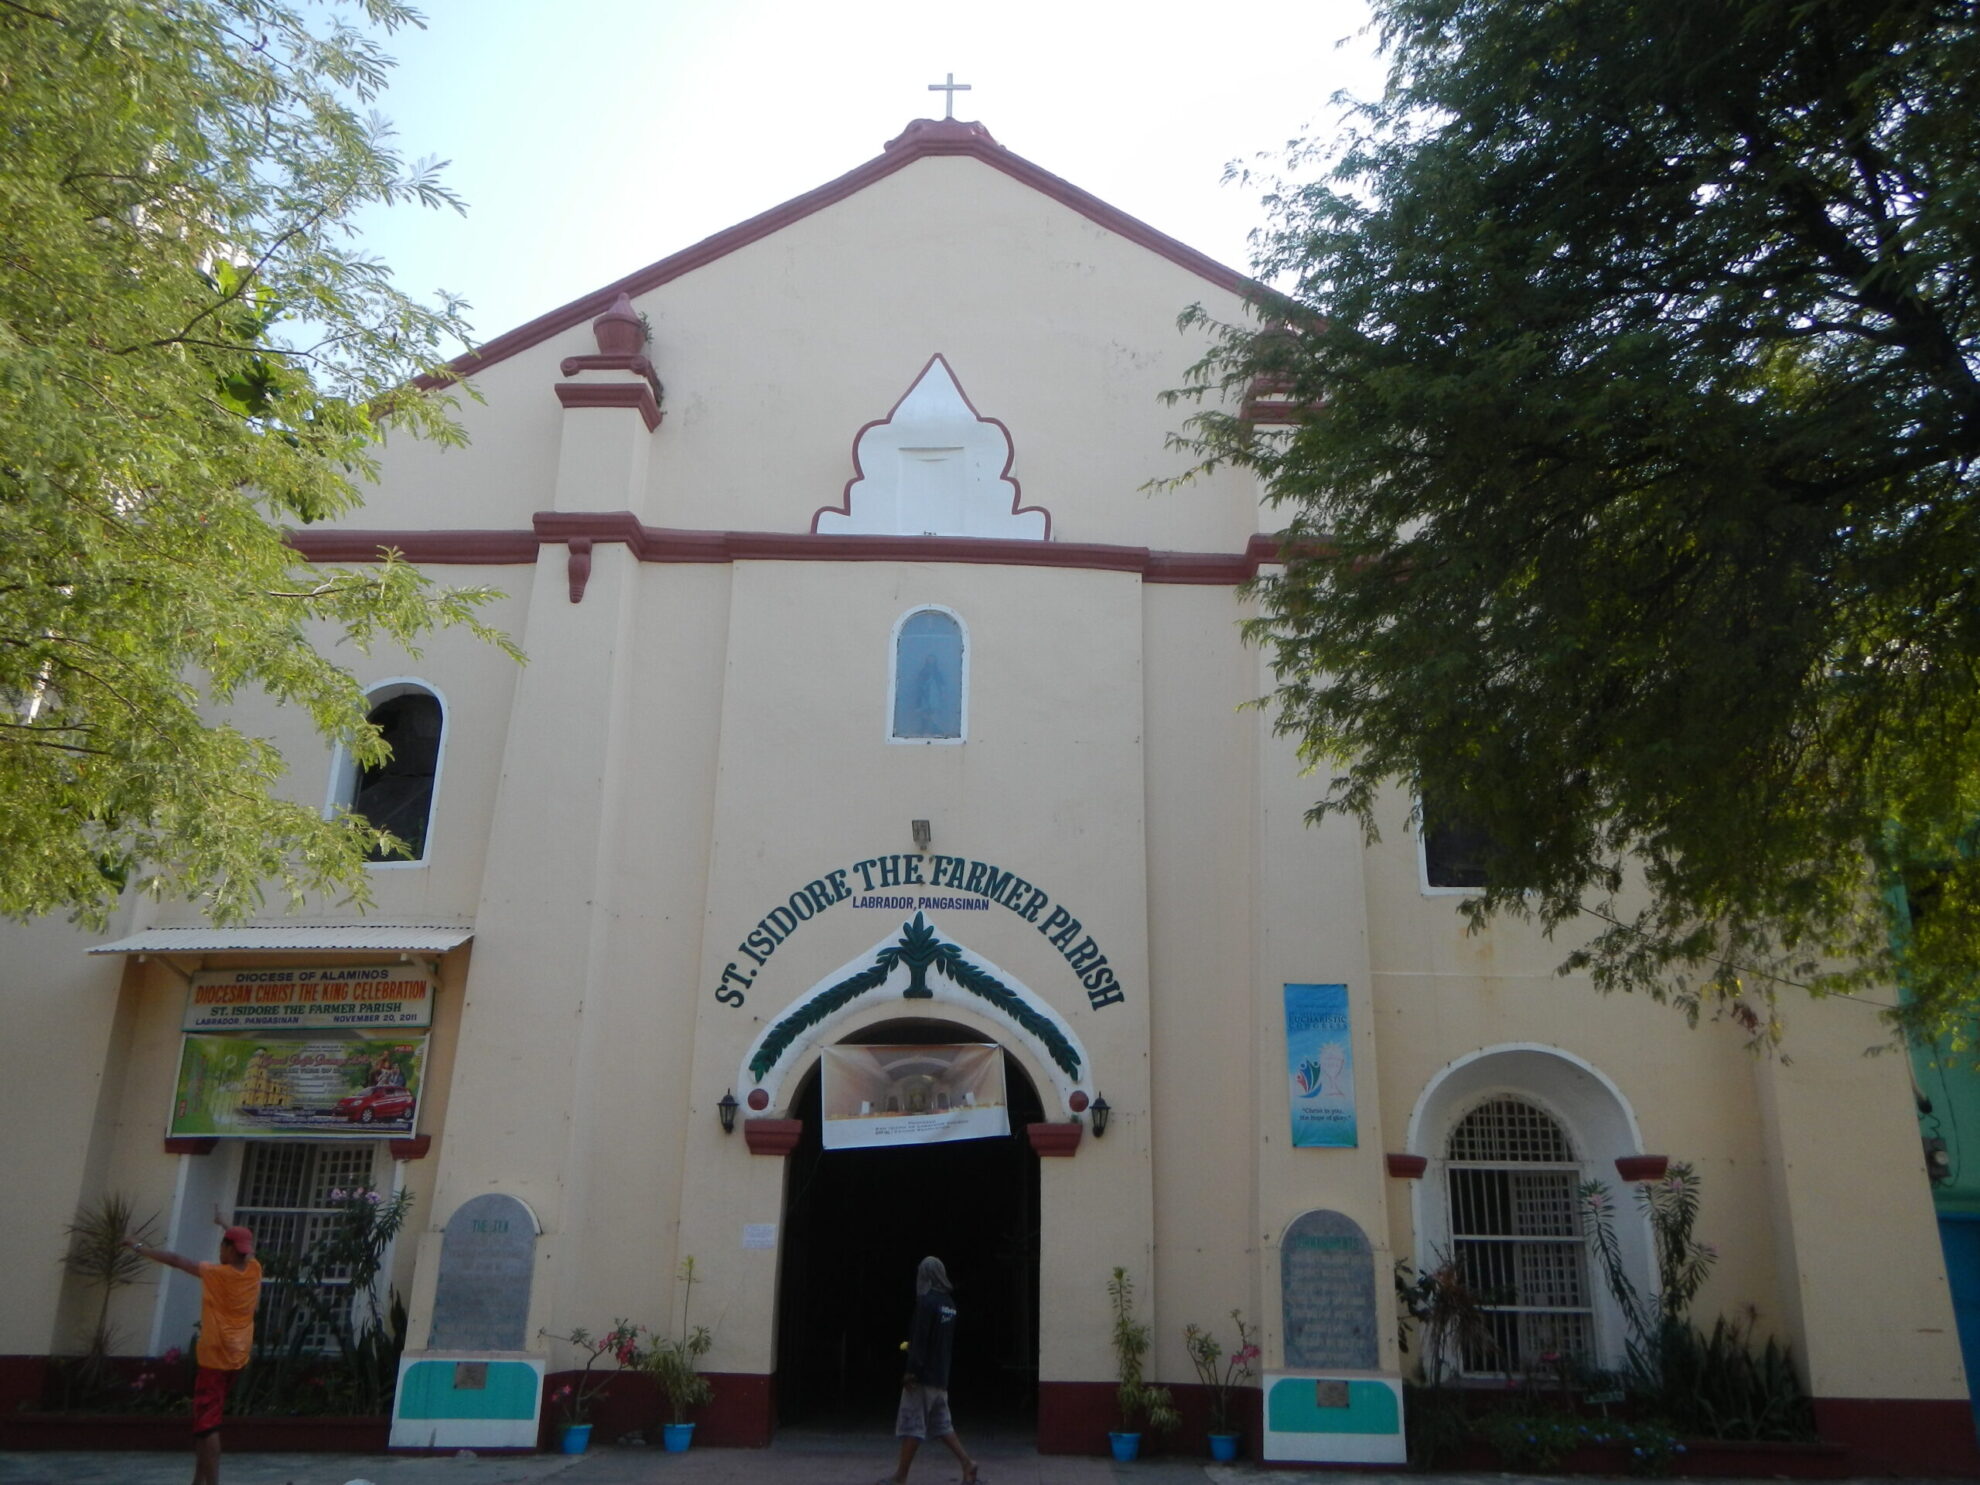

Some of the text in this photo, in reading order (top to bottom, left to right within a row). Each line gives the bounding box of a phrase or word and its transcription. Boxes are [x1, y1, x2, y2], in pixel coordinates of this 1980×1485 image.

[715, 855, 1125, 1011] ST. ISIDORE THE FARMER PARISH
[235, 969, 389, 983] DIOCESE OF ALAMINOS
[195, 980, 427, 1004] DIOCESAN CHRIST THE KING CELEBRATION
[210, 1002, 402, 1016] ST. ISIDORE THE FARMER PARISH
[244, 1016, 299, 1025] PANGASINAN
[333, 1014, 380, 1023] NOVEMBER
[399, 1013, 418, 1021] 2011
